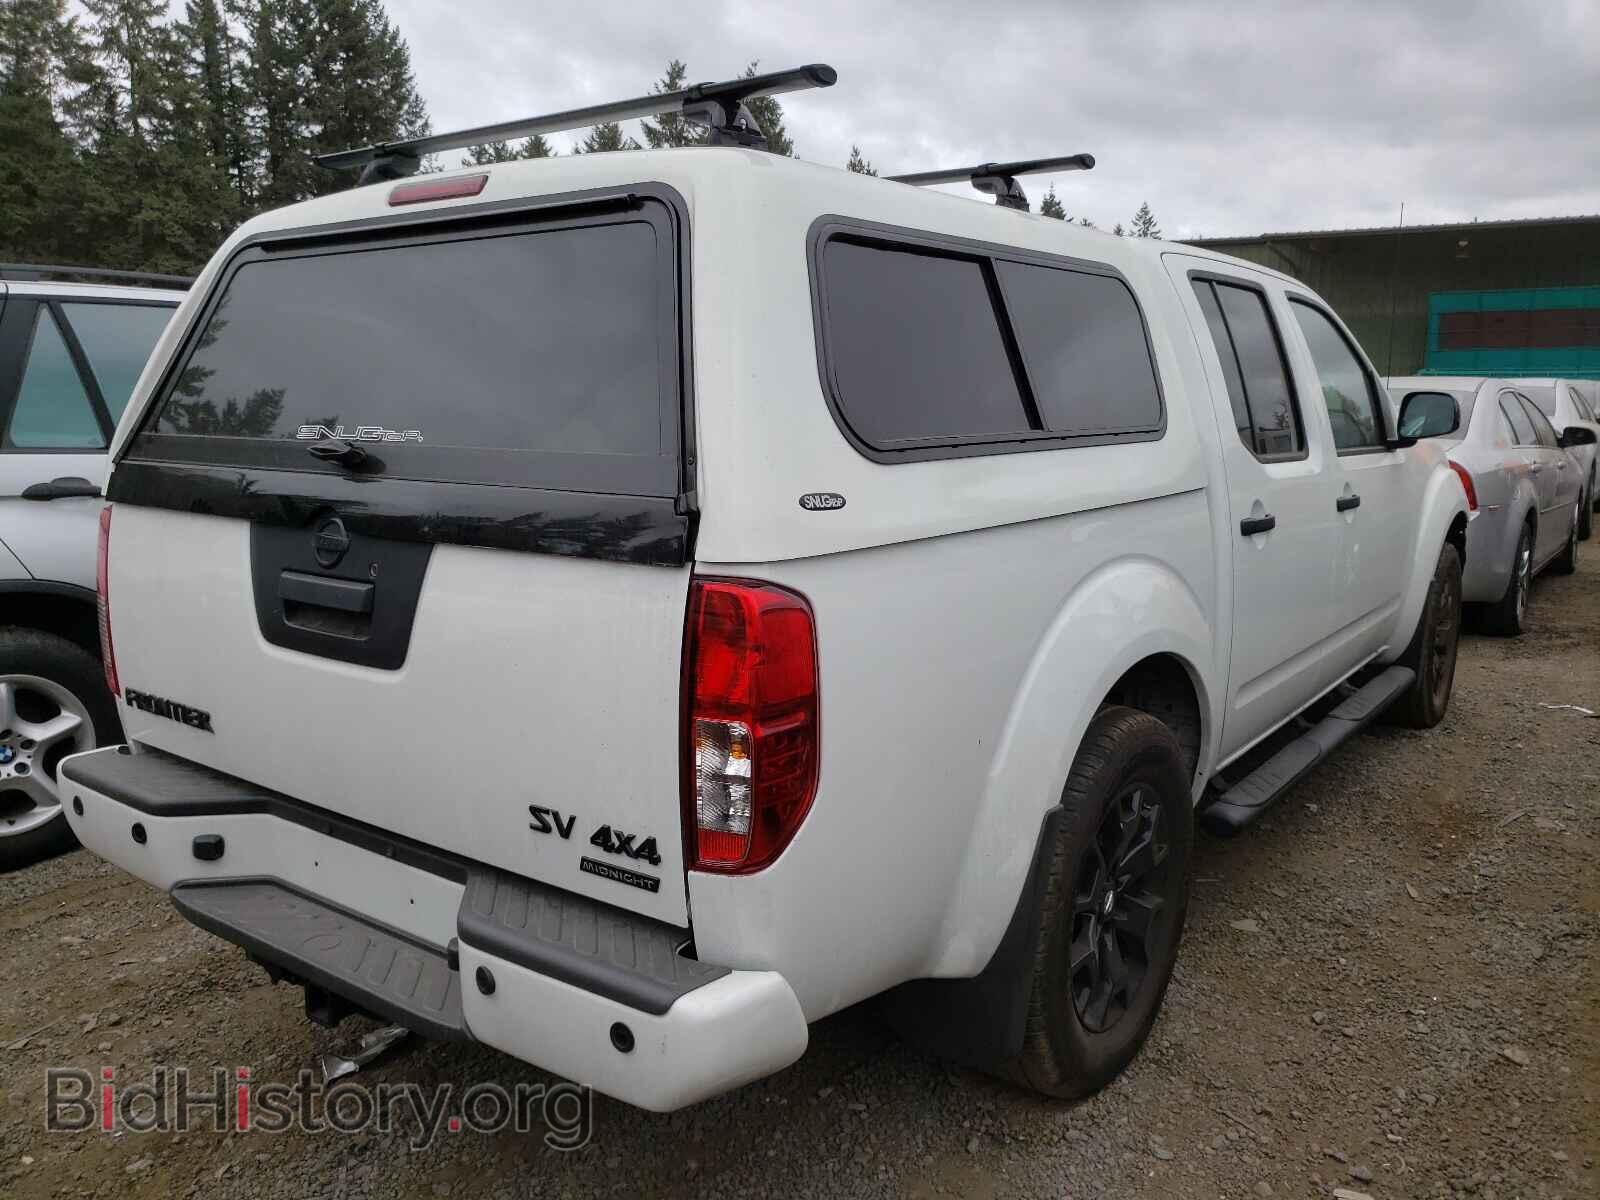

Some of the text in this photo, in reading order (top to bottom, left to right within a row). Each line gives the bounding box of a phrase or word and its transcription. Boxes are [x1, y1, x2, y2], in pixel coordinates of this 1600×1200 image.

[125, 687, 214, 734] FRONTIER
[529, 804, 577, 839] SV
[582, 861, 656, 889] MIDNIGHT
